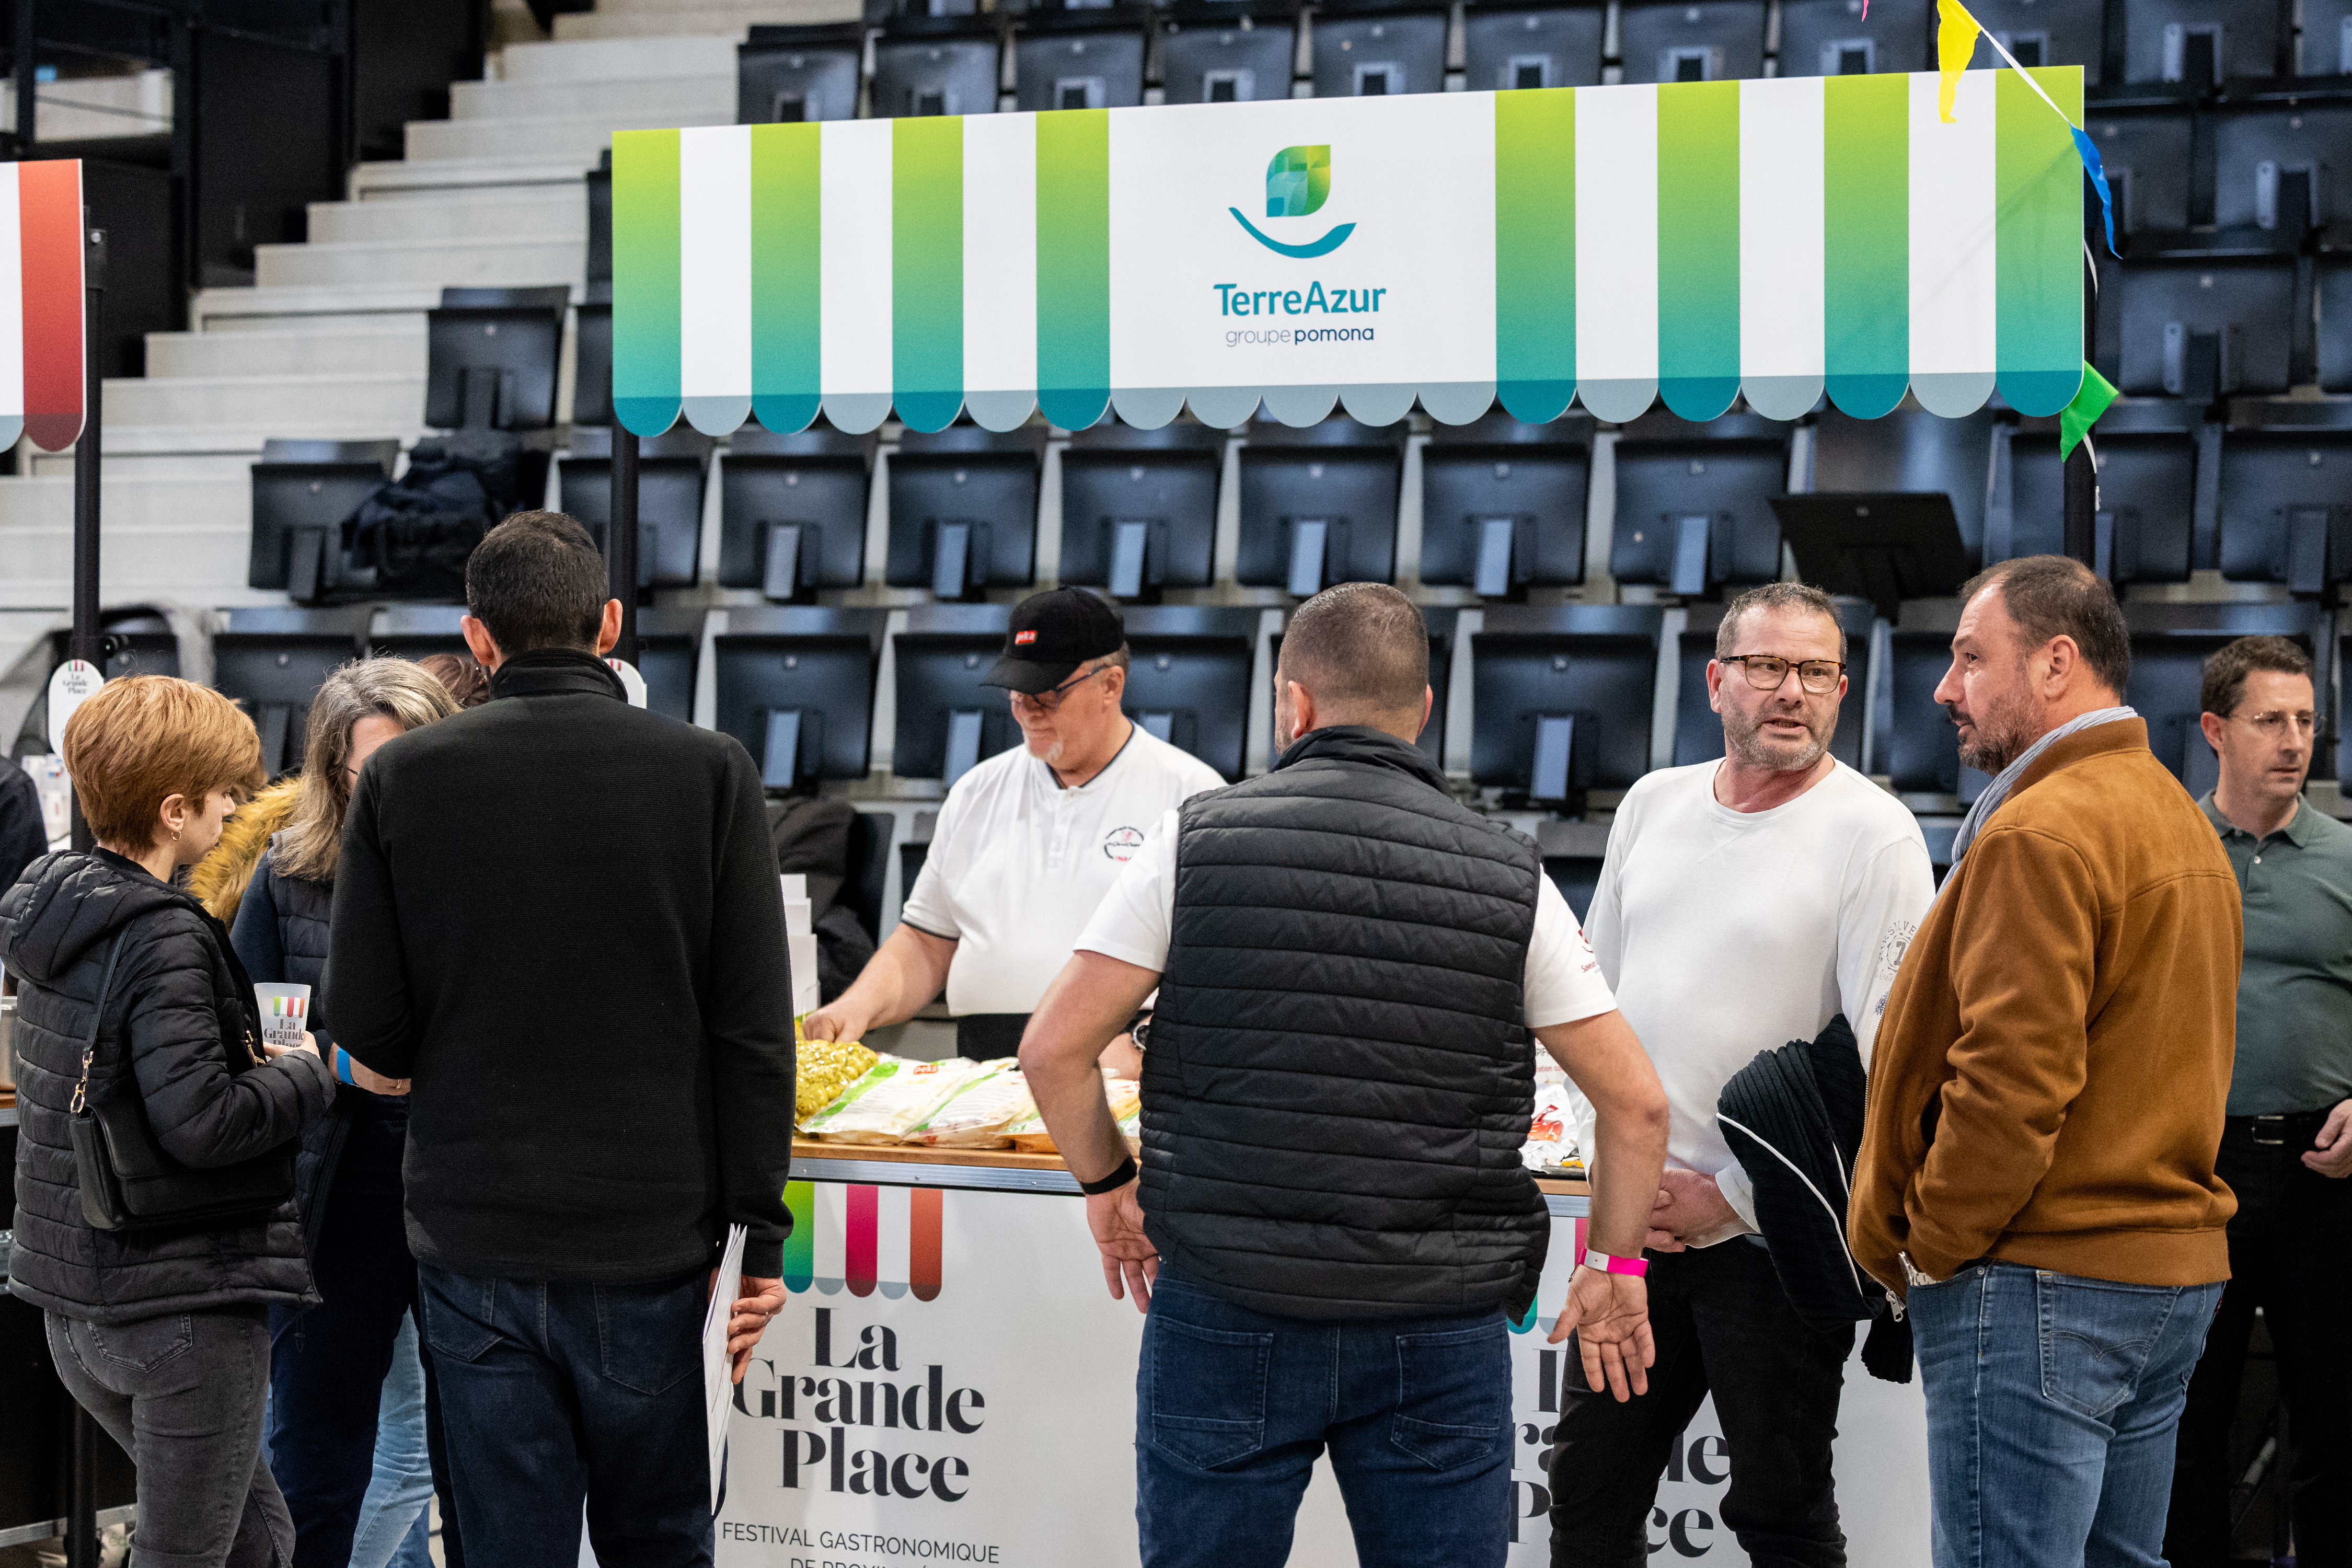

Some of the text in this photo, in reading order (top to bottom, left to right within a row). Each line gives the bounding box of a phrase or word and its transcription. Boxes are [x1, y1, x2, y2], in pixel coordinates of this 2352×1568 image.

[1213, 280, 1387, 316] TerreAzur
[1226, 327, 1375, 348] groupe pomona
[264, 1028, 304, 1040] Grande
[280, 1019, 296, 1030] La
[808, 1306, 902, 1373] La
[732, 1358, 985, 1434] Grande
[776, 1426, 970, 1503] Place
[722, 1522, 1000, 1564] FESTIVAL GASTRONOMIQUE
